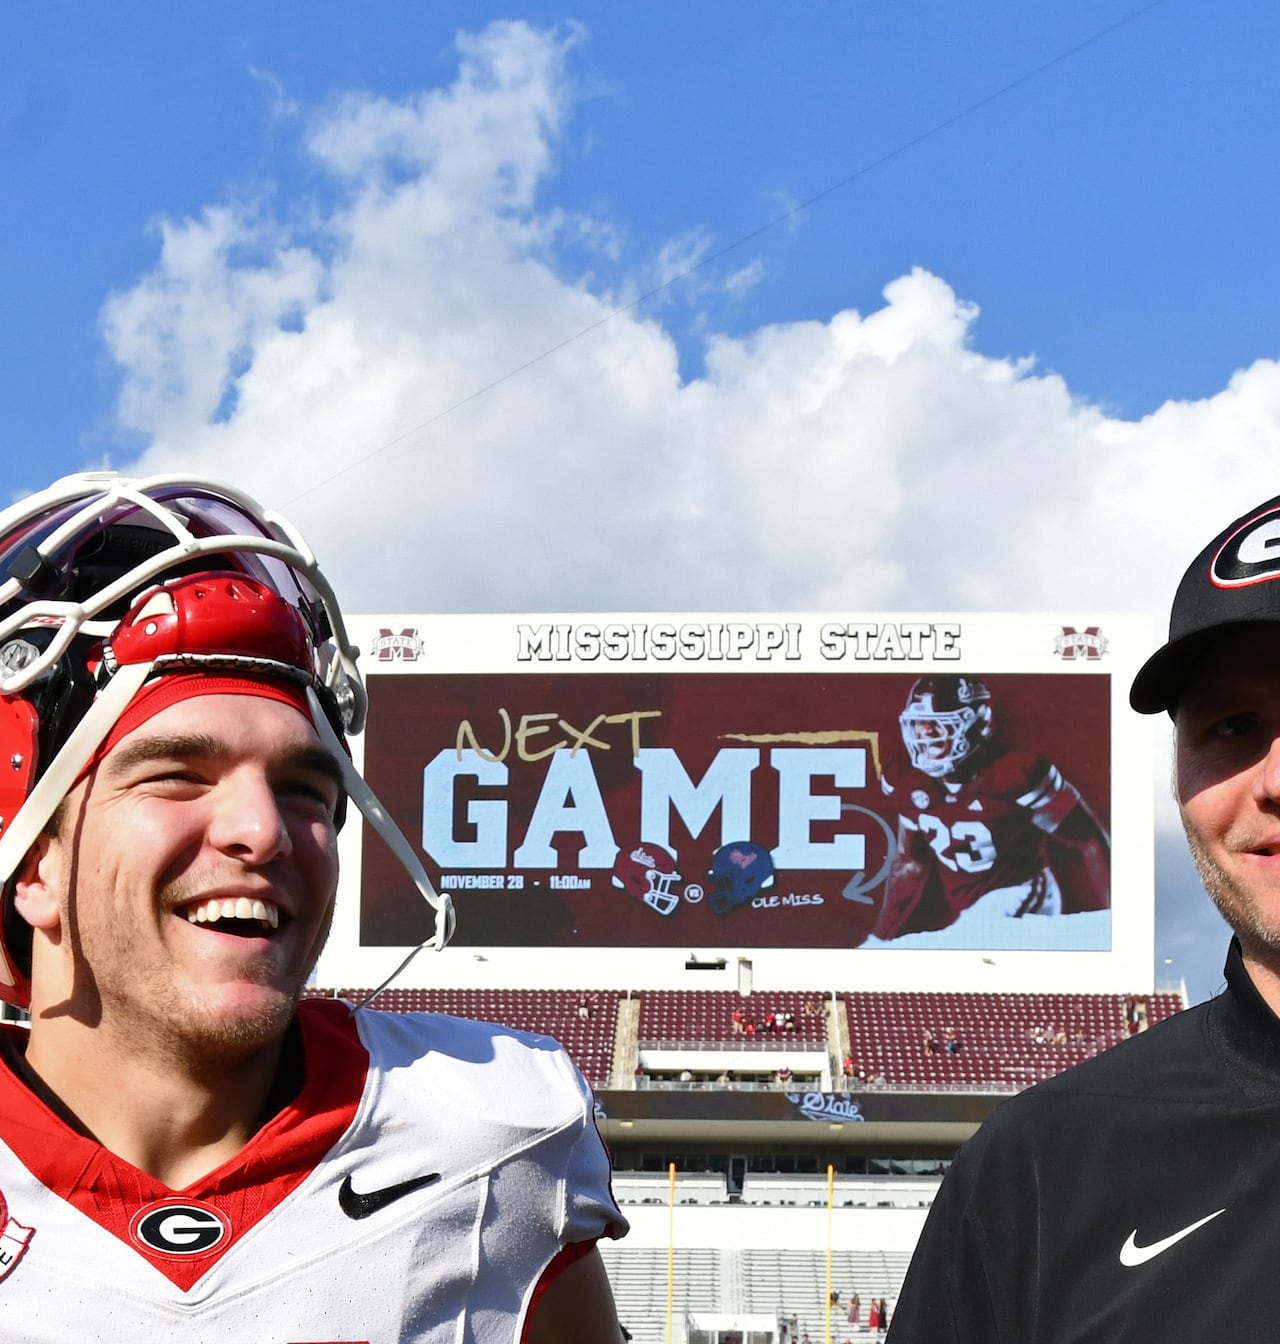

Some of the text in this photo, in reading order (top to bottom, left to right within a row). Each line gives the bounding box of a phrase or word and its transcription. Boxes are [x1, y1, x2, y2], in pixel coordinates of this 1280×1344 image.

[517, 623, 962, 661] MISSISSIPPI STATE
[457, 708, 662, 763] NEXT
[422, 747, 866, 869] GAME
[440, 875, 504, 889] NOVEMBER
[507, 875, 524, 889] 28
[549, 875, 591, 889] 11:00AM
[751, 892, 825, 909] OLE MISS
[800, 1091, 864, 1121] State
[138, 1205, 223, 1254] G
